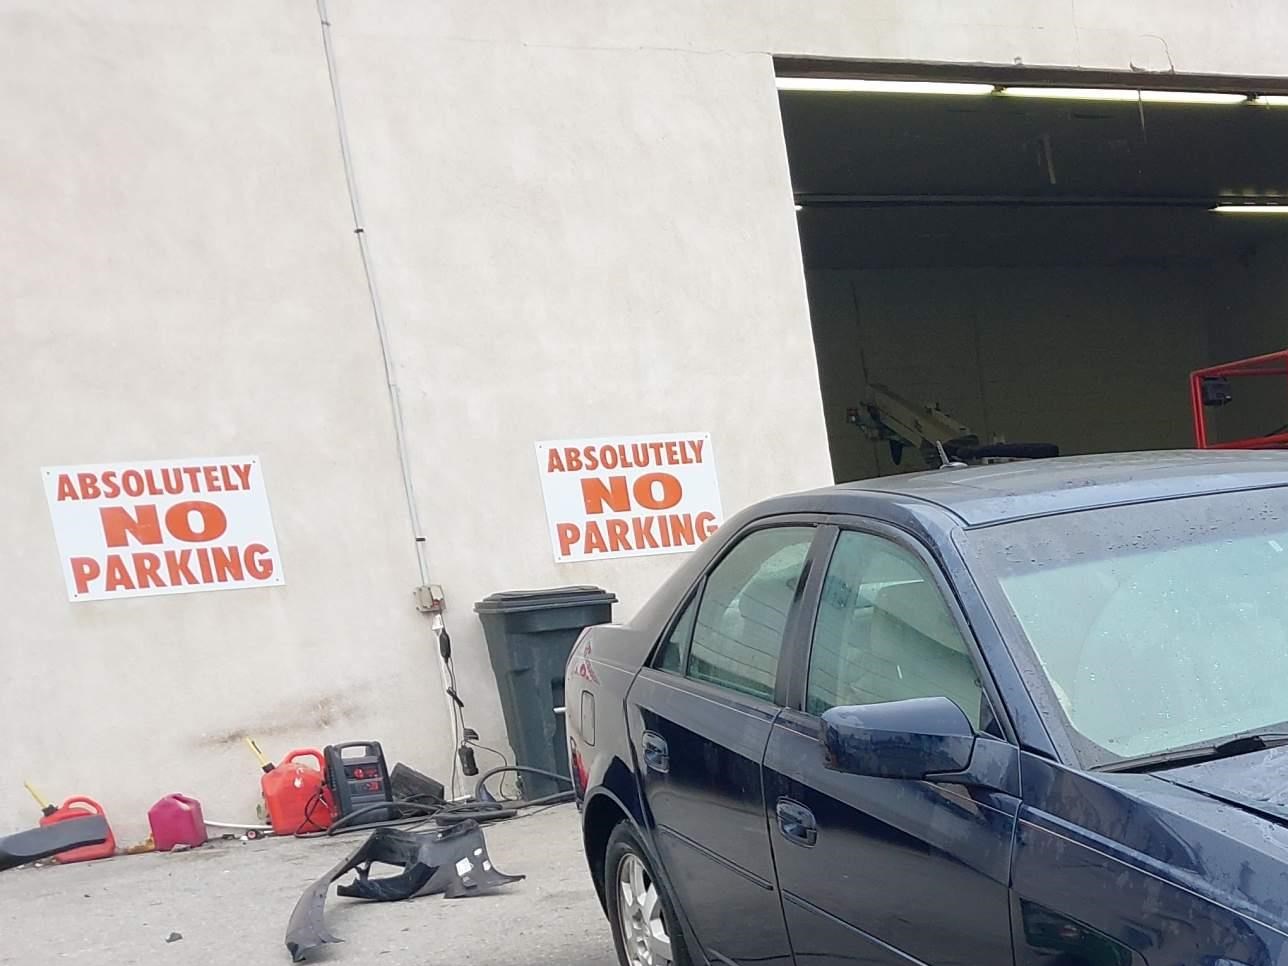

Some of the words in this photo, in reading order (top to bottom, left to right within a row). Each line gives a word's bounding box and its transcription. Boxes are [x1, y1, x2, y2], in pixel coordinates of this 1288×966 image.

[547, 439, 704, 473] ABSOLUTELY
[57, 463, 252, 501] ABSOLUTELY
[580, 472, 683, 515] NO
[99, 500, 227, 548] NO
[556, 511, 719, 556] PARKING
[70, 543, 274, 594] PARKING
